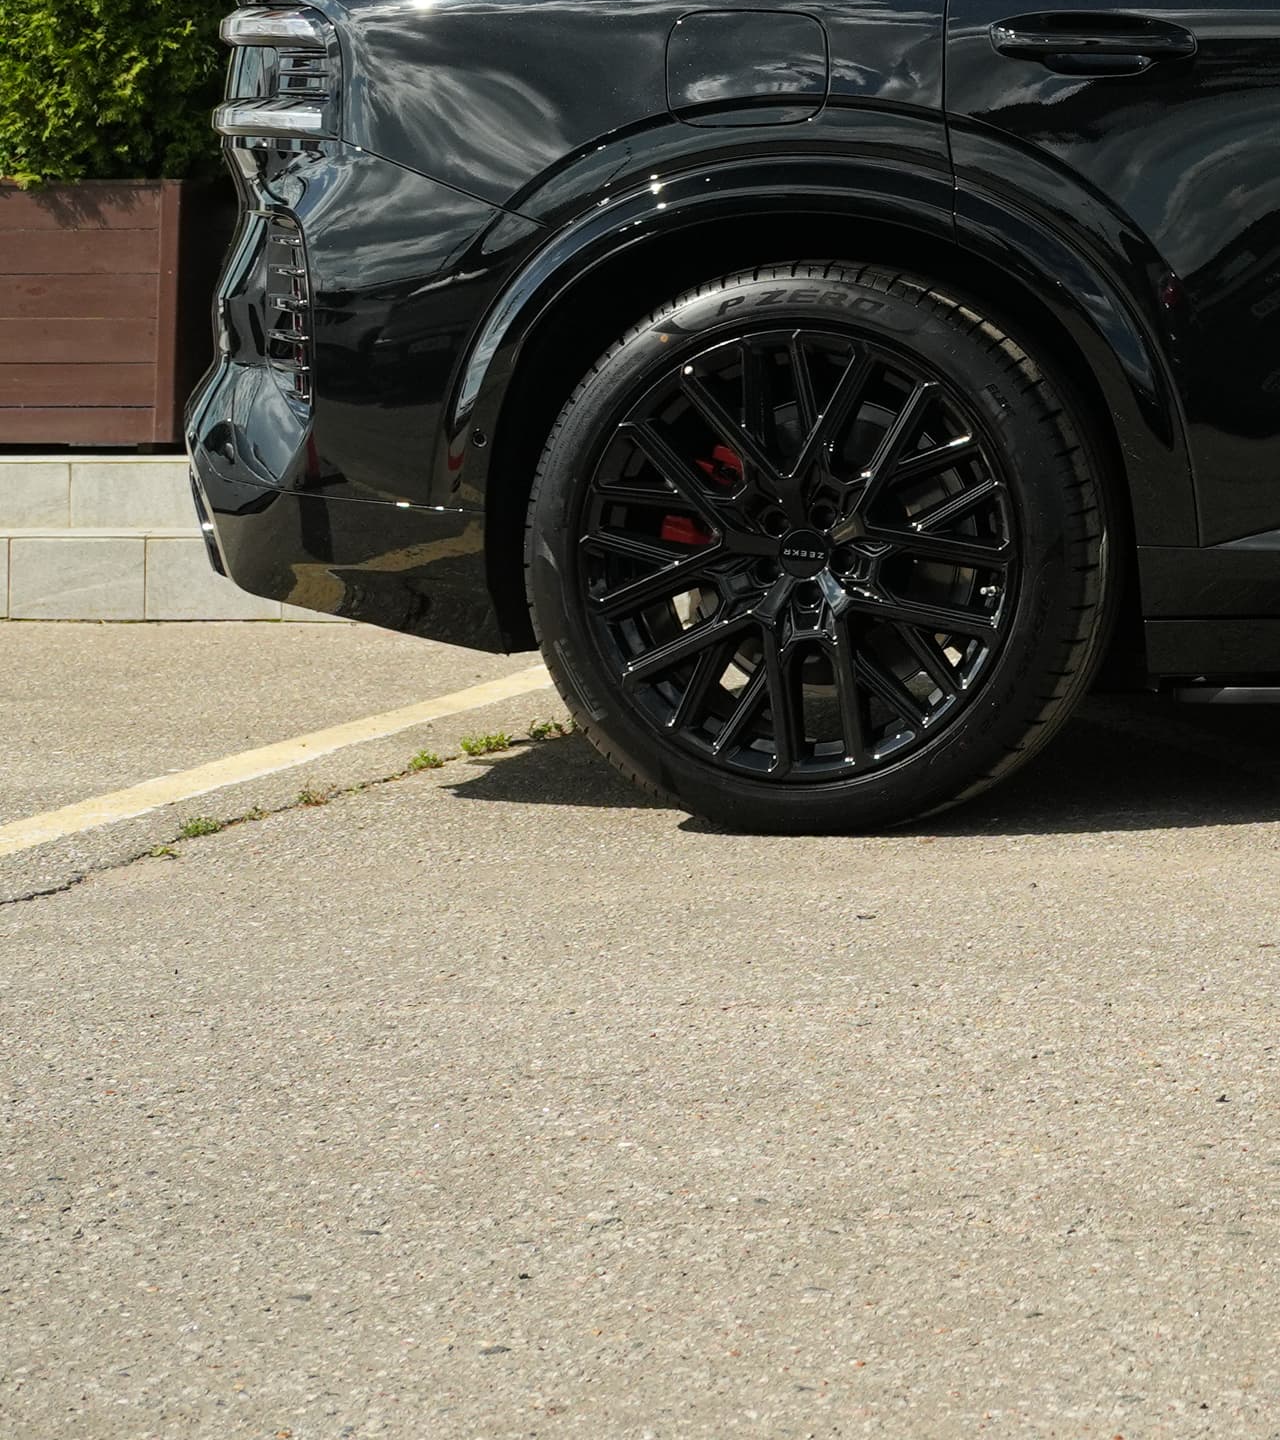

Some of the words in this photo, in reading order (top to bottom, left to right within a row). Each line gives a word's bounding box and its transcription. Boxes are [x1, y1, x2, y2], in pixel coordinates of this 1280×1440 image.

[716, 295, 745, 316] P
[755, 289, 885, 313] ZERO
[783, 547, 825, 560] ZEEKR
